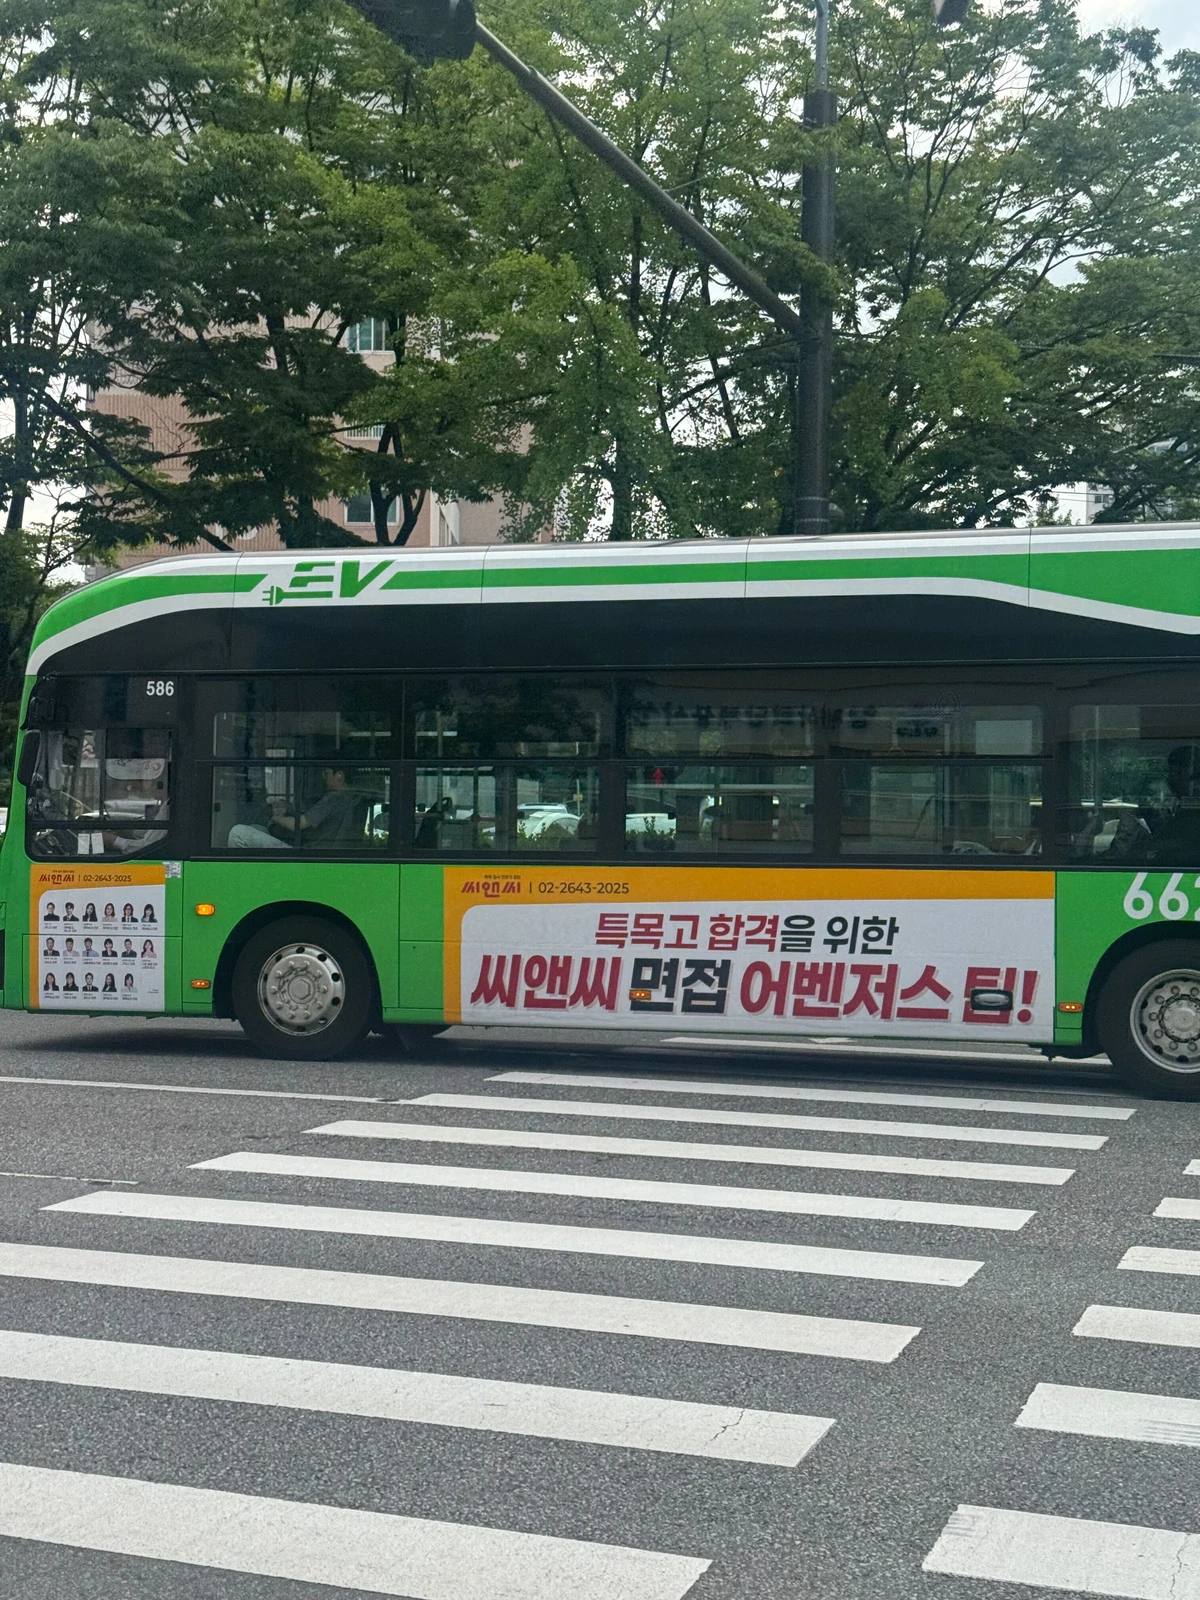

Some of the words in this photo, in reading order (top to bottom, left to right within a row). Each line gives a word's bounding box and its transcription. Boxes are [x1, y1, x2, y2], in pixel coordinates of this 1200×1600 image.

[288, 560, 396, 598] EV
[146, 681, 174, 696] 586
[83, 875, 132, 883] 02-2643-2025
[460, 881, 521, 898] 씨앤씨
[538, 882, 629, 894] 02-2643-2025
[1123, 872, 1200, 920] 66
[595, 913, 699, 949] 특목고
[707, 914, 815, 952] 합격을
[823, 915, 899, 955] 위한
[470, 954, 622, 1011] 씨앤씨
[629, 957, 732, 1014] 면접
[740, 960, 952, 1020] 어벤저스
